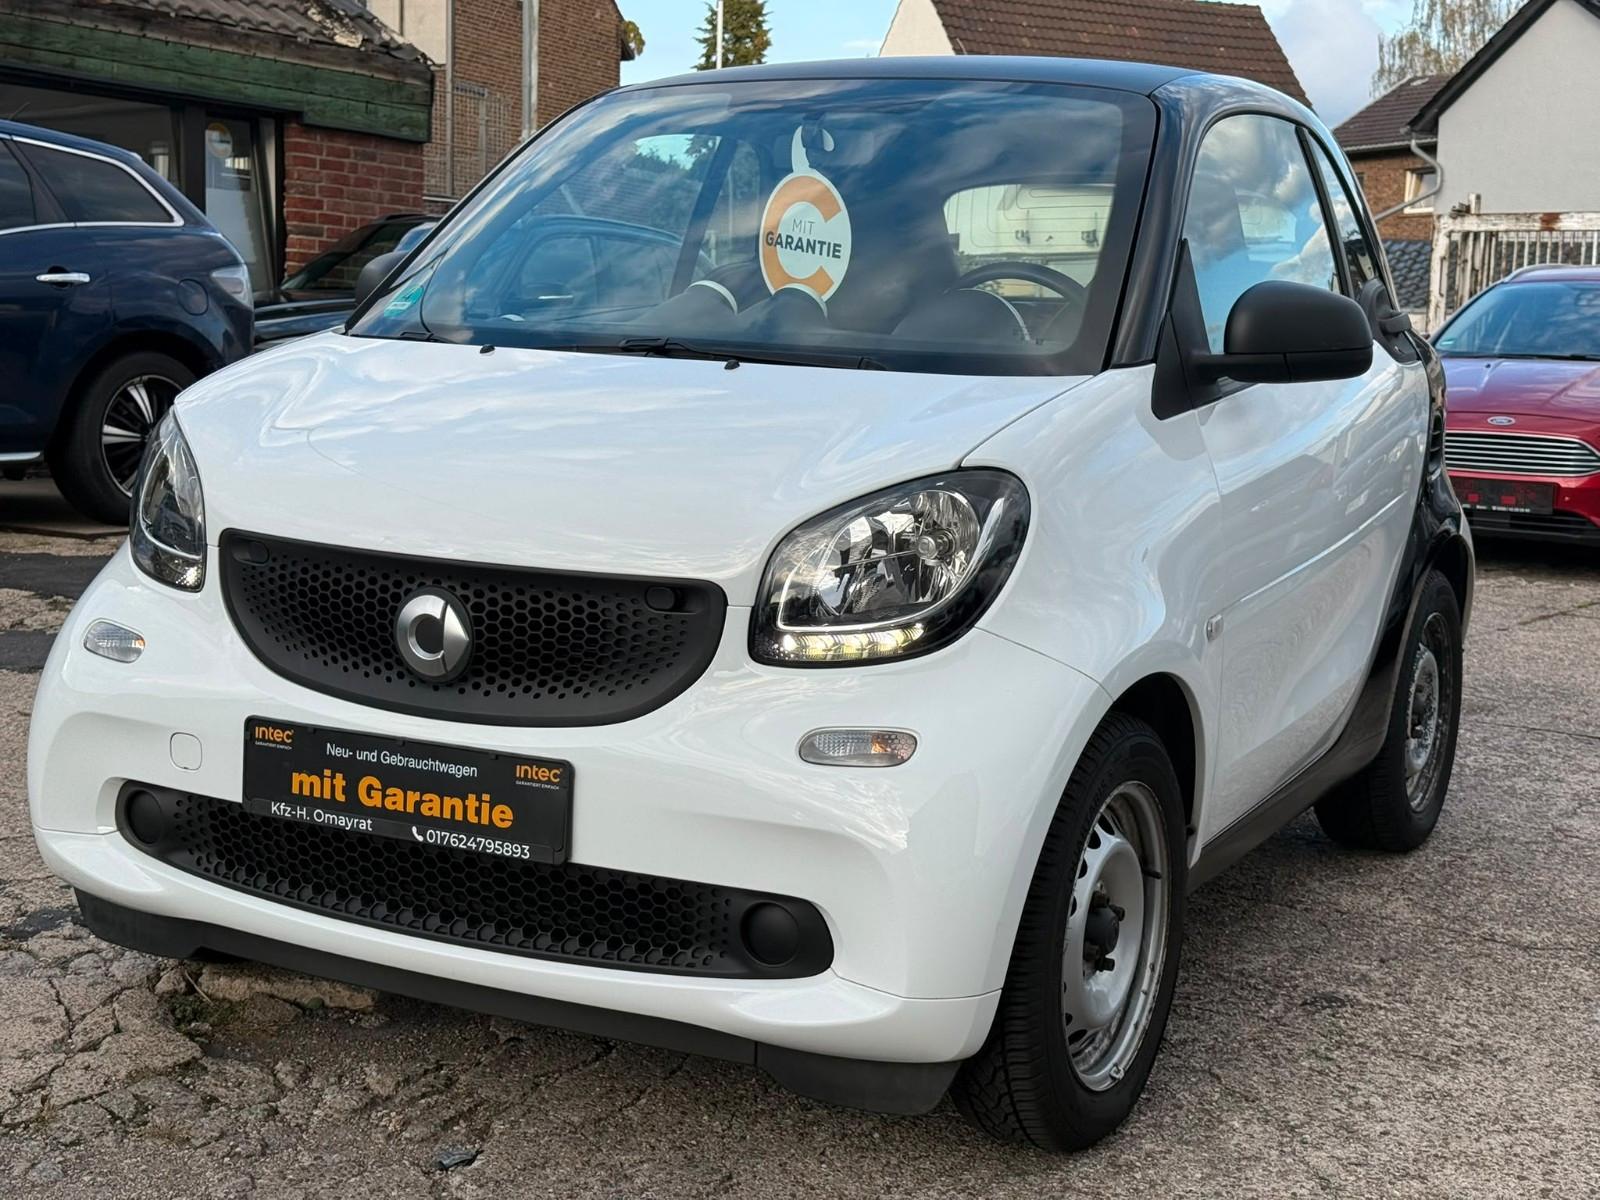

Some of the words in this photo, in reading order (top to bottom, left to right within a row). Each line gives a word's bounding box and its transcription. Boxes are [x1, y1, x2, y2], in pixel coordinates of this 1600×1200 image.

[791, 218, 816, 235] MIT
[765, 230, 842, 259] GARANTIE
[255, 726, 294, 743] intec
[326, 743, 353, 758] Neu-
[356, 748, 378, 763] und
[381, 751, 478, 779] Gebrauchtwagen
[516, 764, 561, 783] intec
[291, 769, 346, 802] mit
[358, 776, 514, 828] Garantie
[271, 801, 310, 821] Kfz-H.
[313, 809, 373, 831] Omayrat
[426, 829, 530, 859] 017624795893
